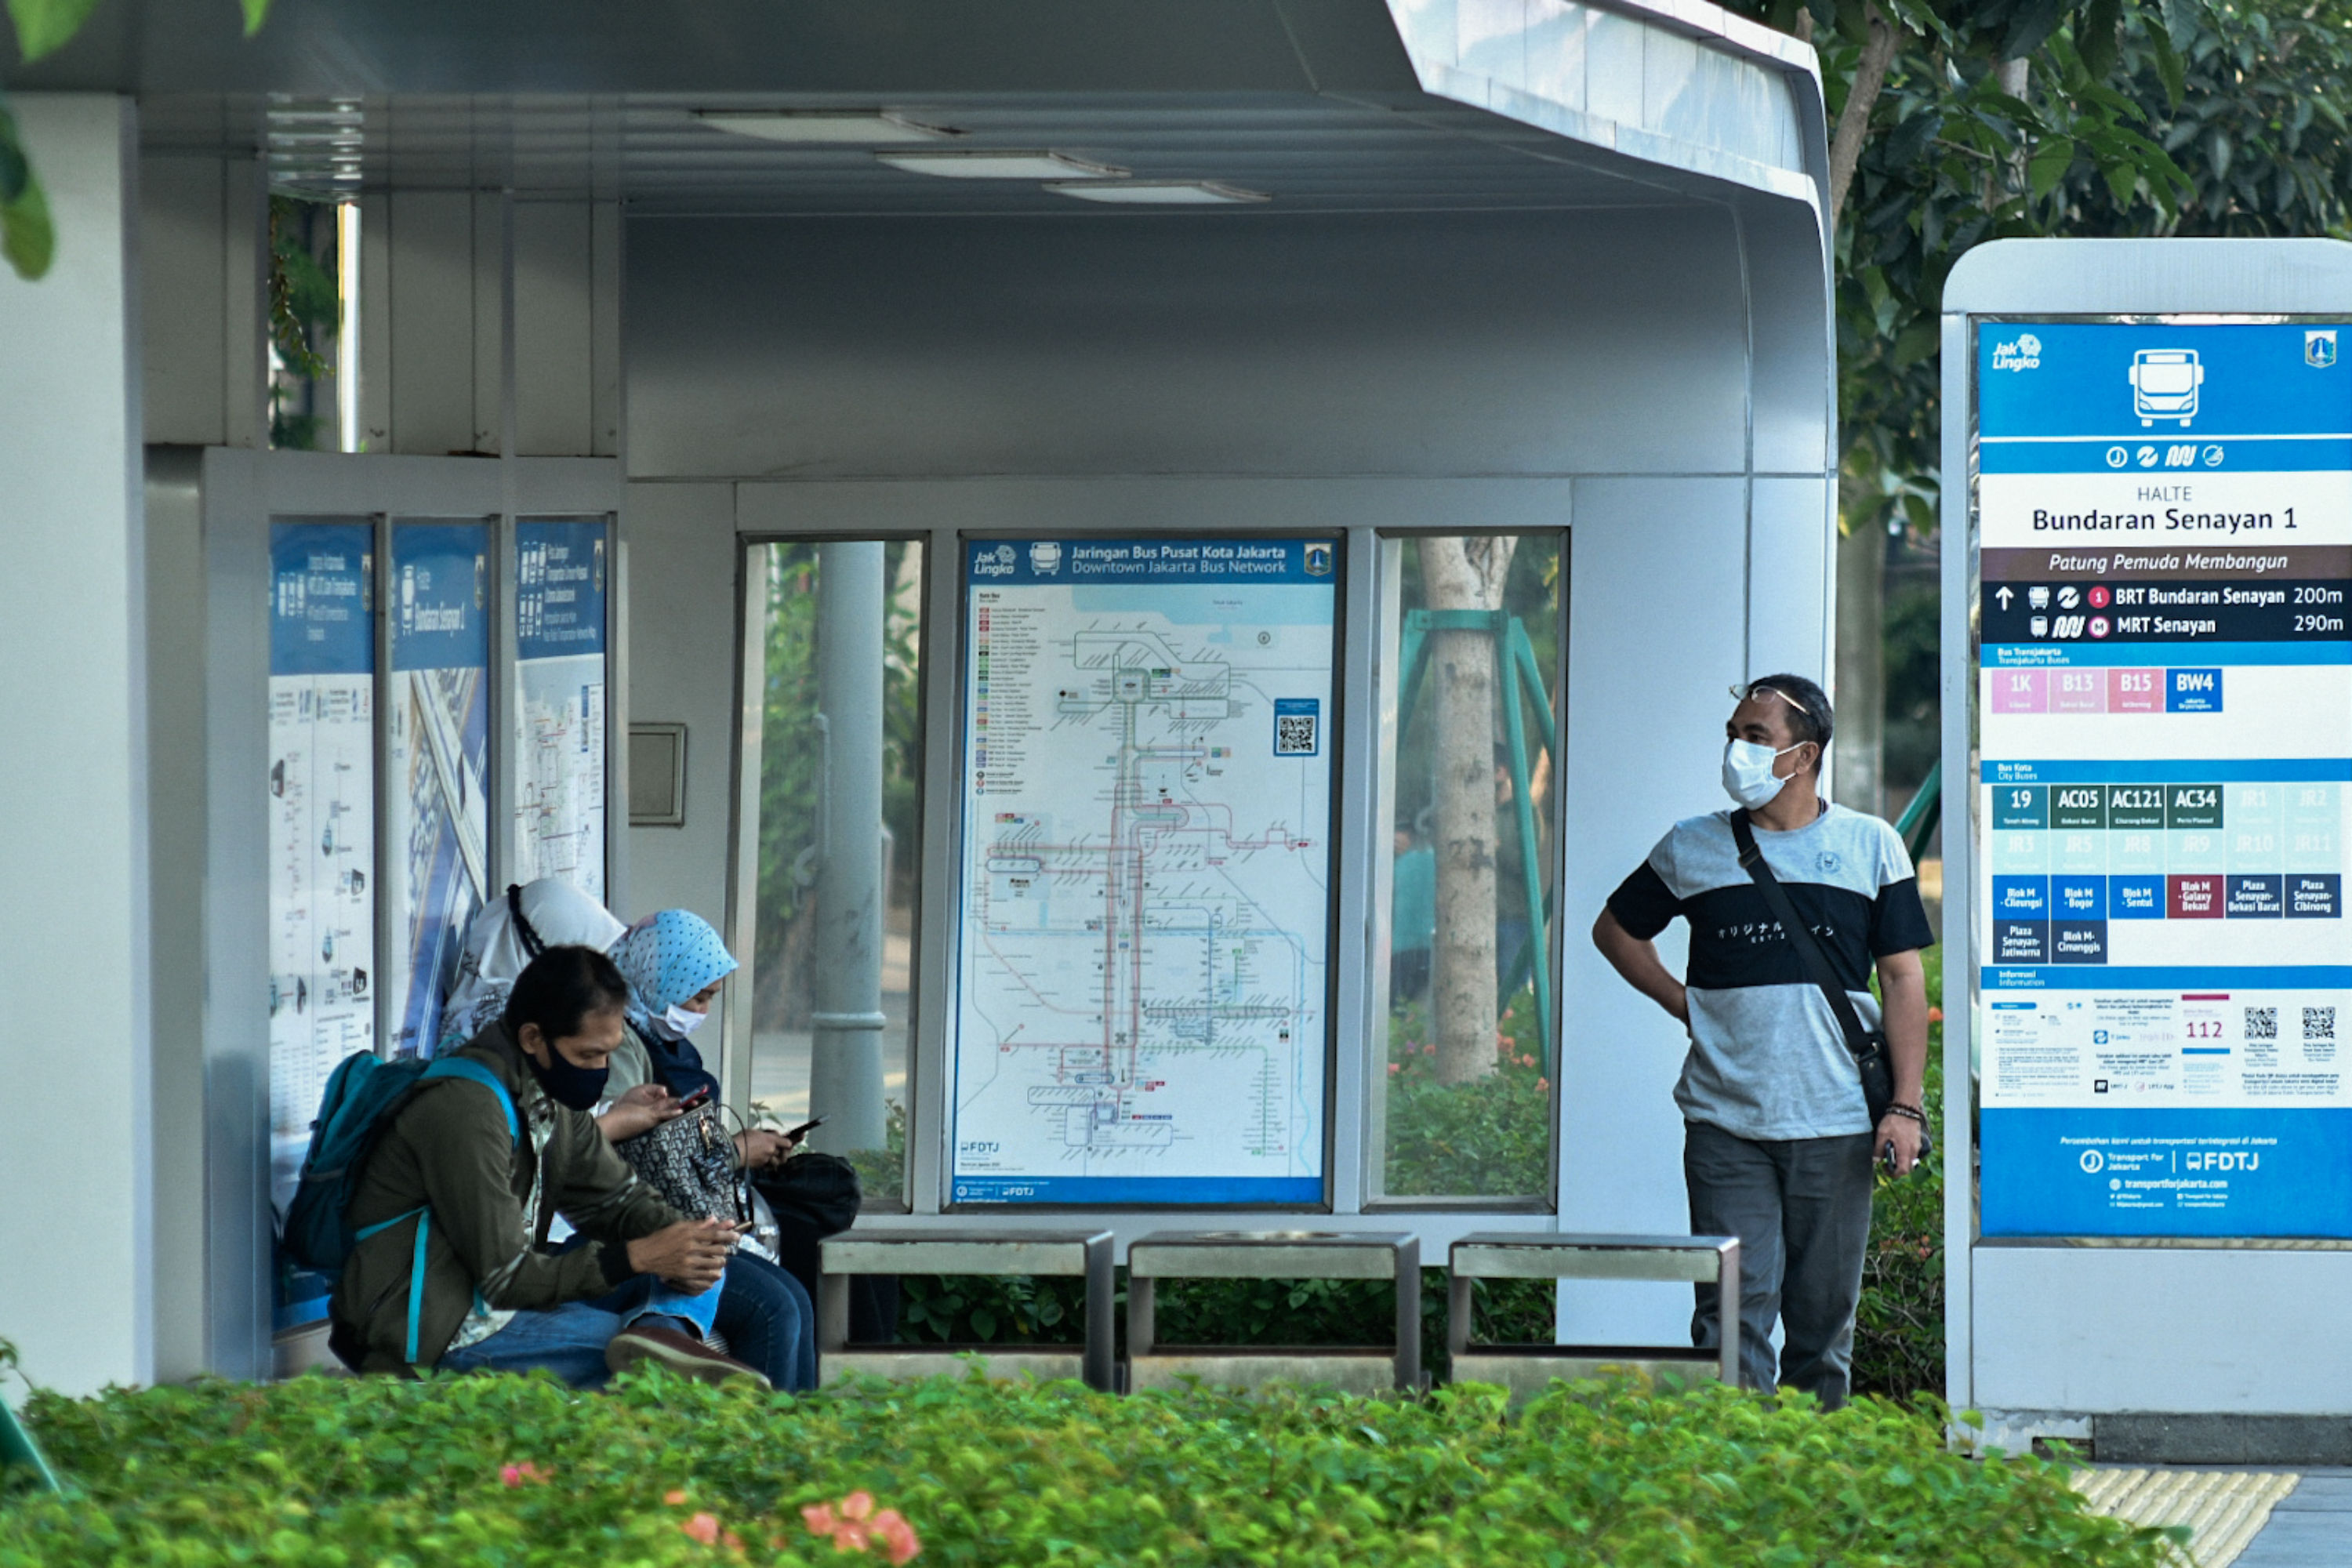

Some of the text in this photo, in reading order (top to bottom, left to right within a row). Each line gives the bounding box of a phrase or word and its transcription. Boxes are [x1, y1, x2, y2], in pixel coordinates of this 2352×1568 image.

[1992, 343, 2018, 355] Jak
[1992, 356, 2040, 372] Lingko
[2137, 486, 2193, 502] HALTE
[2032, 507, 2297, 535] Bundaran Senayan 1
[975, 552, 996, 564] Jak
[1072, 546, 1286, 562] Jaringan Bus Pusat Kota Jakarta
[1072, 560, 1287, 574] Downtown Jakarta Bus Network
[2049, 553, 2288, 574] Patung Pemuda Membangun
[974, 564, 1015, 577] Lingko
[2095, 586, 2343, 608] 1 BRT Bundaran Senayan 200m
[2118, 616, 2151, 633] MRT
[2154, 615, 2216, 637] Senayan
[2294, 615, 2344, 631] 290m
[2013, 648, 2062, 657] Transjakarta
[2010, 673, 2033, 692] 1K
[2062, 673, 2094, 692] B13
[2121, 673, 2152, 691] B15
[2176, 673, 2214, 691] BW4
[1998, 763, 2033, 772] Bus Kota
[1998, 771, 2038, 782] City Buses
[2010, 789, 2033, 808] 19
[2057, 789, 2100, 808] AC05
[2111, 789, 2163, 808] AC121
[2174, 789, 2218, 808] AC34
[2007, 835, 2035, 853] JR3
[2064, 835, 2093, 853] JR5
[2182, 834, 2210, 853] JR9
[2235, 834, 2274, 852] JR10
[2180, 880, 2211, 891] Blok M
[2241, 880, 2266, 891] Plaza
[2300, 880, 2325, 891] Plaza
[2006, 887, 2036, 898] Blok M
[2064, 887, 2094, 898] Blok M
[2122, 887, 2152, 898] Blok M
[2183, 891, 2212, 902] Galaxy
[2235, 890, 2274, 902] Senayan-
[2293, 890, 2332, 902] Senayan-
[2004, 897, 2043, 909] Cileungsi
[2068, 897, 2094, 909] Bogor
[2126, 897, 2154, 908] Sentul
[2182, 901, 2210, 911] Bekasi
[2227, 901, 2280, 912] Bekasi Barat
[2293, 901, 2332, 913] Cibinong
[2009, 925, 2033, 936] Plaza
[2063, 931, 2082, 942] Blok
[2002, 936, 2041, 949] Senayan-
[2056, 941, 2101, 954] Cimanggis
[1998, 970, 2037, 978] Informasi
[1998, 978, 2045, 987] Information
[2186, 1020, 2223, 1039] 112
[2250, 1137, 2278, 1145] Jakarta
[969, 1142, 1000, 1153] FDTJ
[2107, 1152, 2165, 1162] Transport for
[2204, 1152, 2259, 1171] FDTJ
[2107, 1163, 2141, 1171] Jakarta
[2124, 1178, 2229, 1191] transportforjakarta.com
[1009, 1187, 1035, 1196] FDTJ
